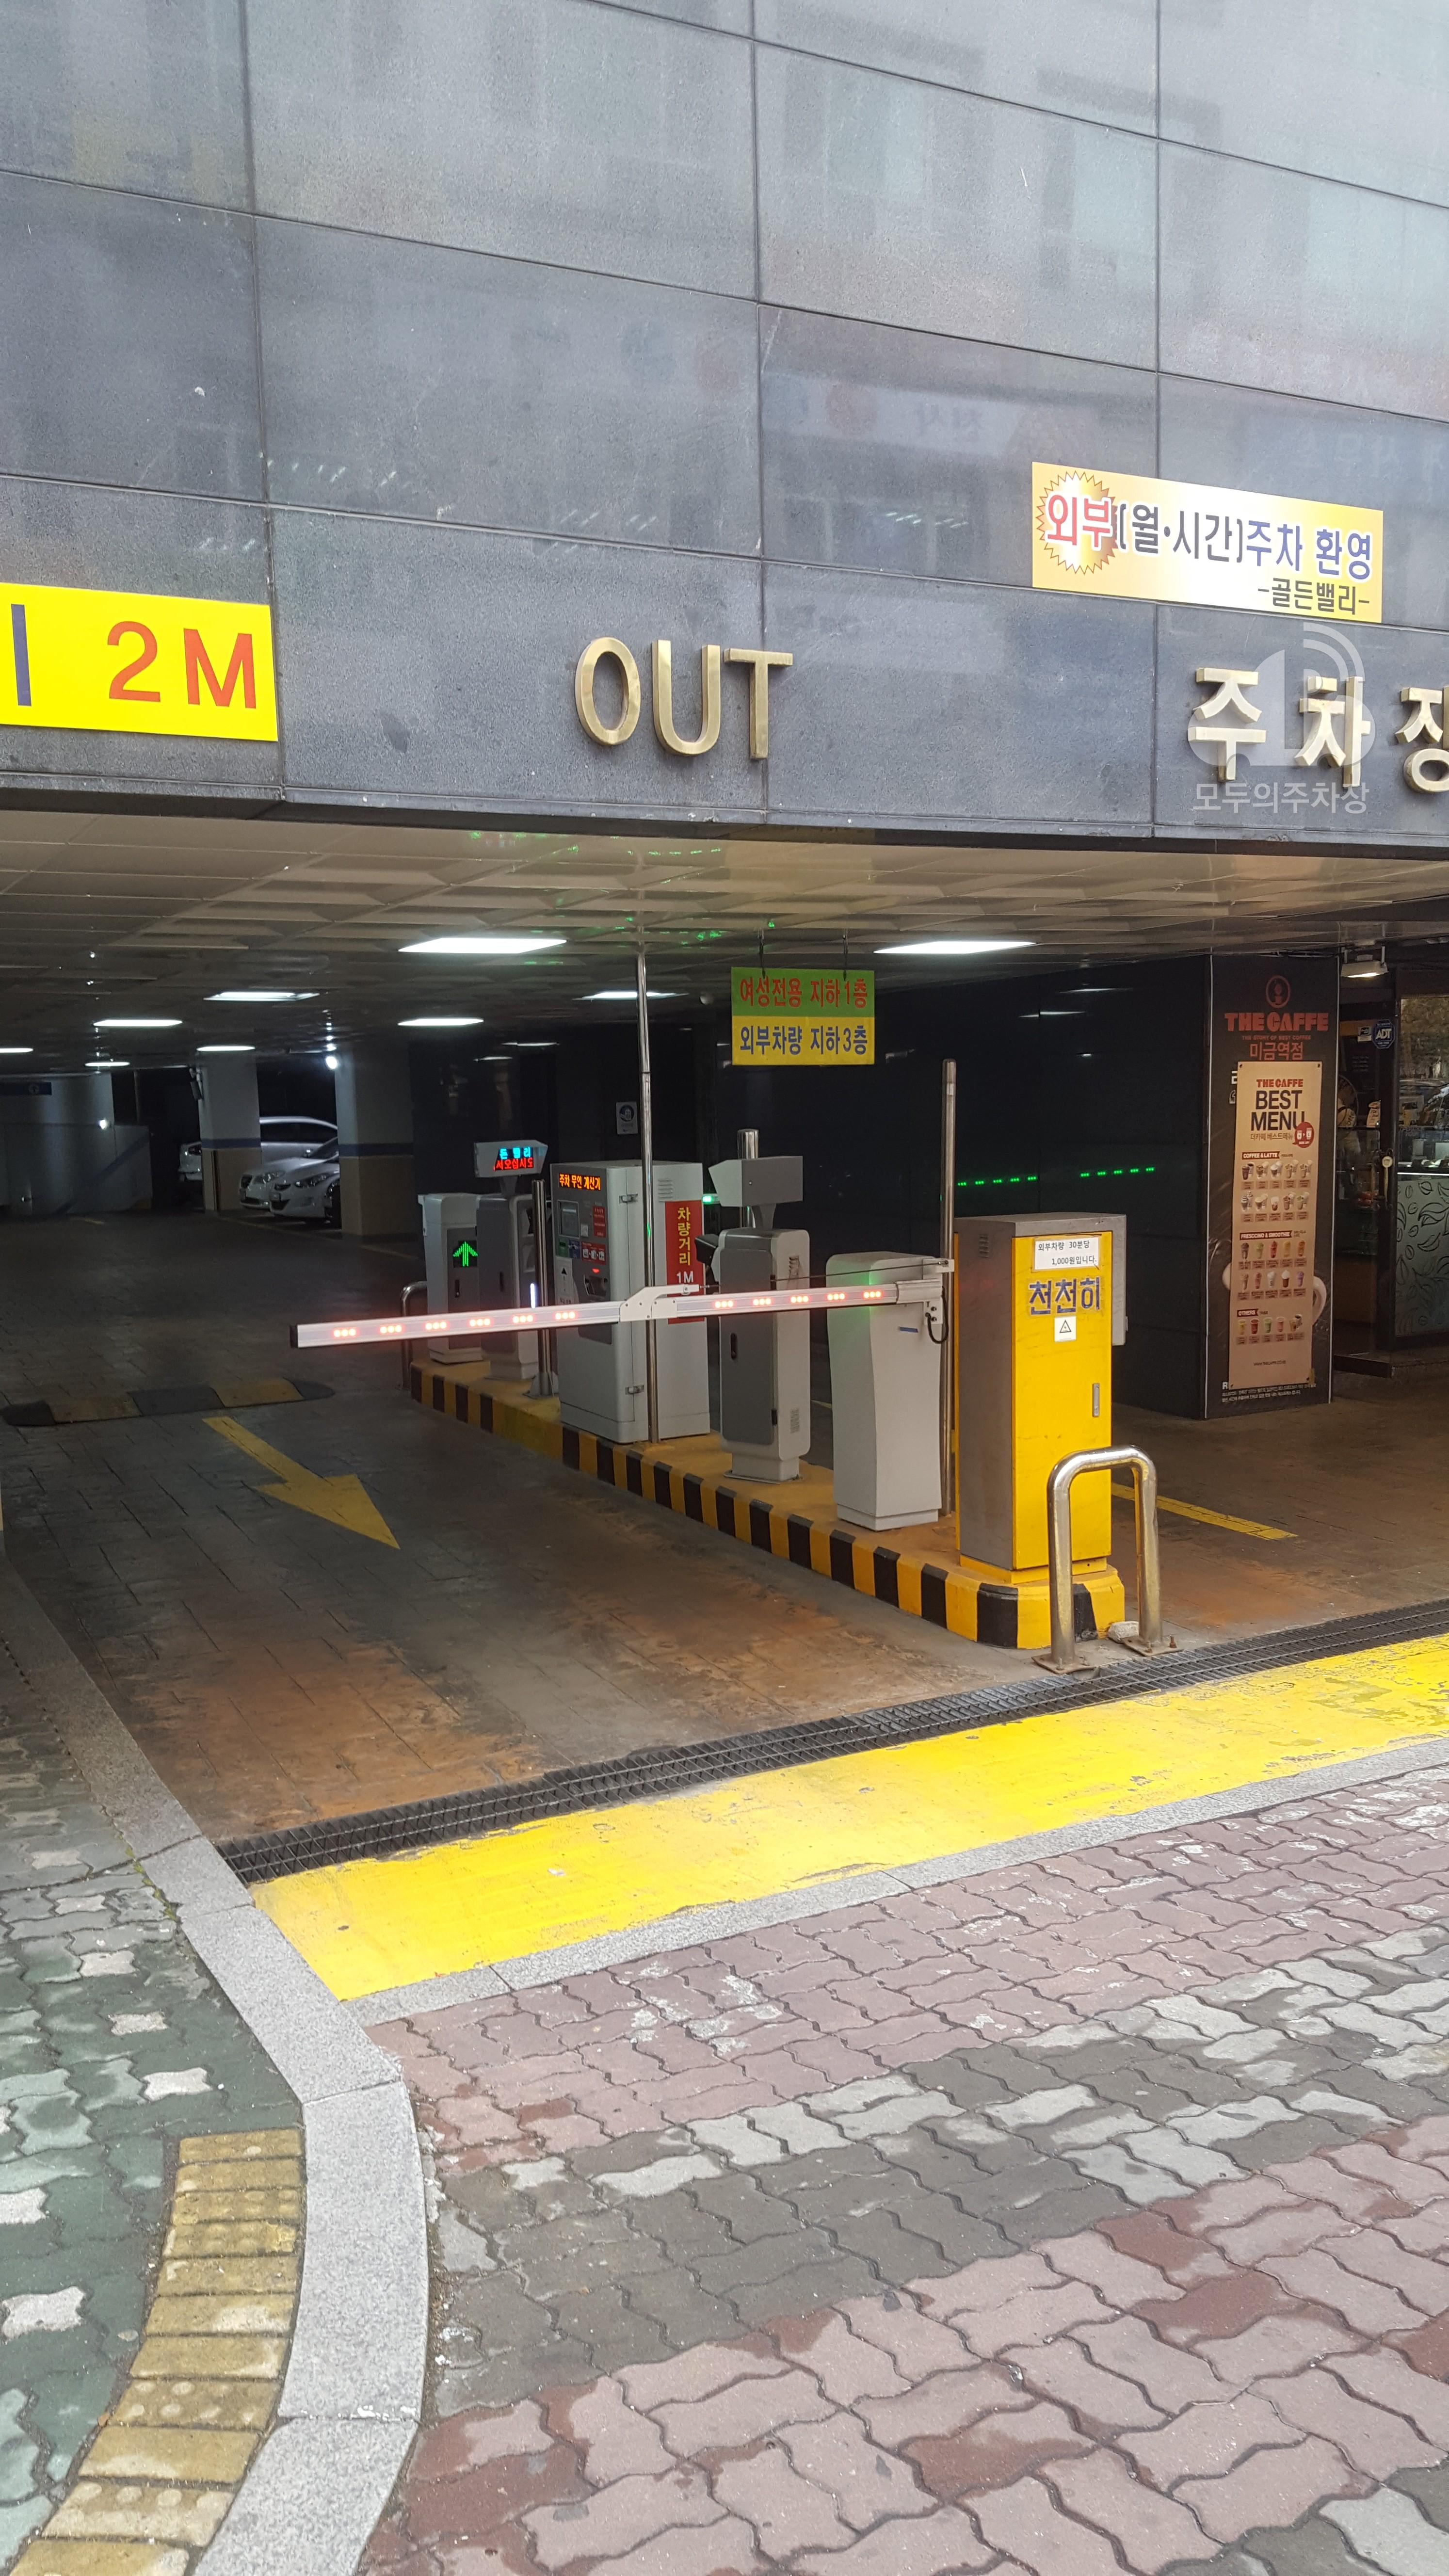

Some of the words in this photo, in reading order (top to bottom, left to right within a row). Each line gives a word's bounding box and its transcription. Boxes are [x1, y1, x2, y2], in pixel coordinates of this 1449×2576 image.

[1315, 528, 1372, 580] 환영
[575, 637, 793, 760] OUT
[740, 976, 802, 1008] 여성전용
[1224, 1012, 1264, 1031] THE
[1267, 1012, 1328, 1031] CAFFE
[740, 1026, 803, 1055] 외부차량
[1375, 1029, 1392, 1039] ADT
[1250, 1042, 1303, 1061] 미금역점
[1256, 1079, 1274, 1088] THE
[1275, 1079, 1304, 1087] CAFFE
[1256, 1090, 1303, 1110] BEST
[1251, 1111, 1305, 1131] MENU
[559, 1174, 570, 1188] 주차
[571, 1175, 582, 1189] 무인
[677, 1207, 691, 1266] 차량거리
[1038, 1242, 1064, 1251] 외부차량
[1069, 1240, 1090, 1249] 30분당
[1052, 1255, 1097, 1266] 1,000원입니다.
[676, 1271, 694, 1284] 1M
[1029, 1276, 1100, 1315] 천천히
